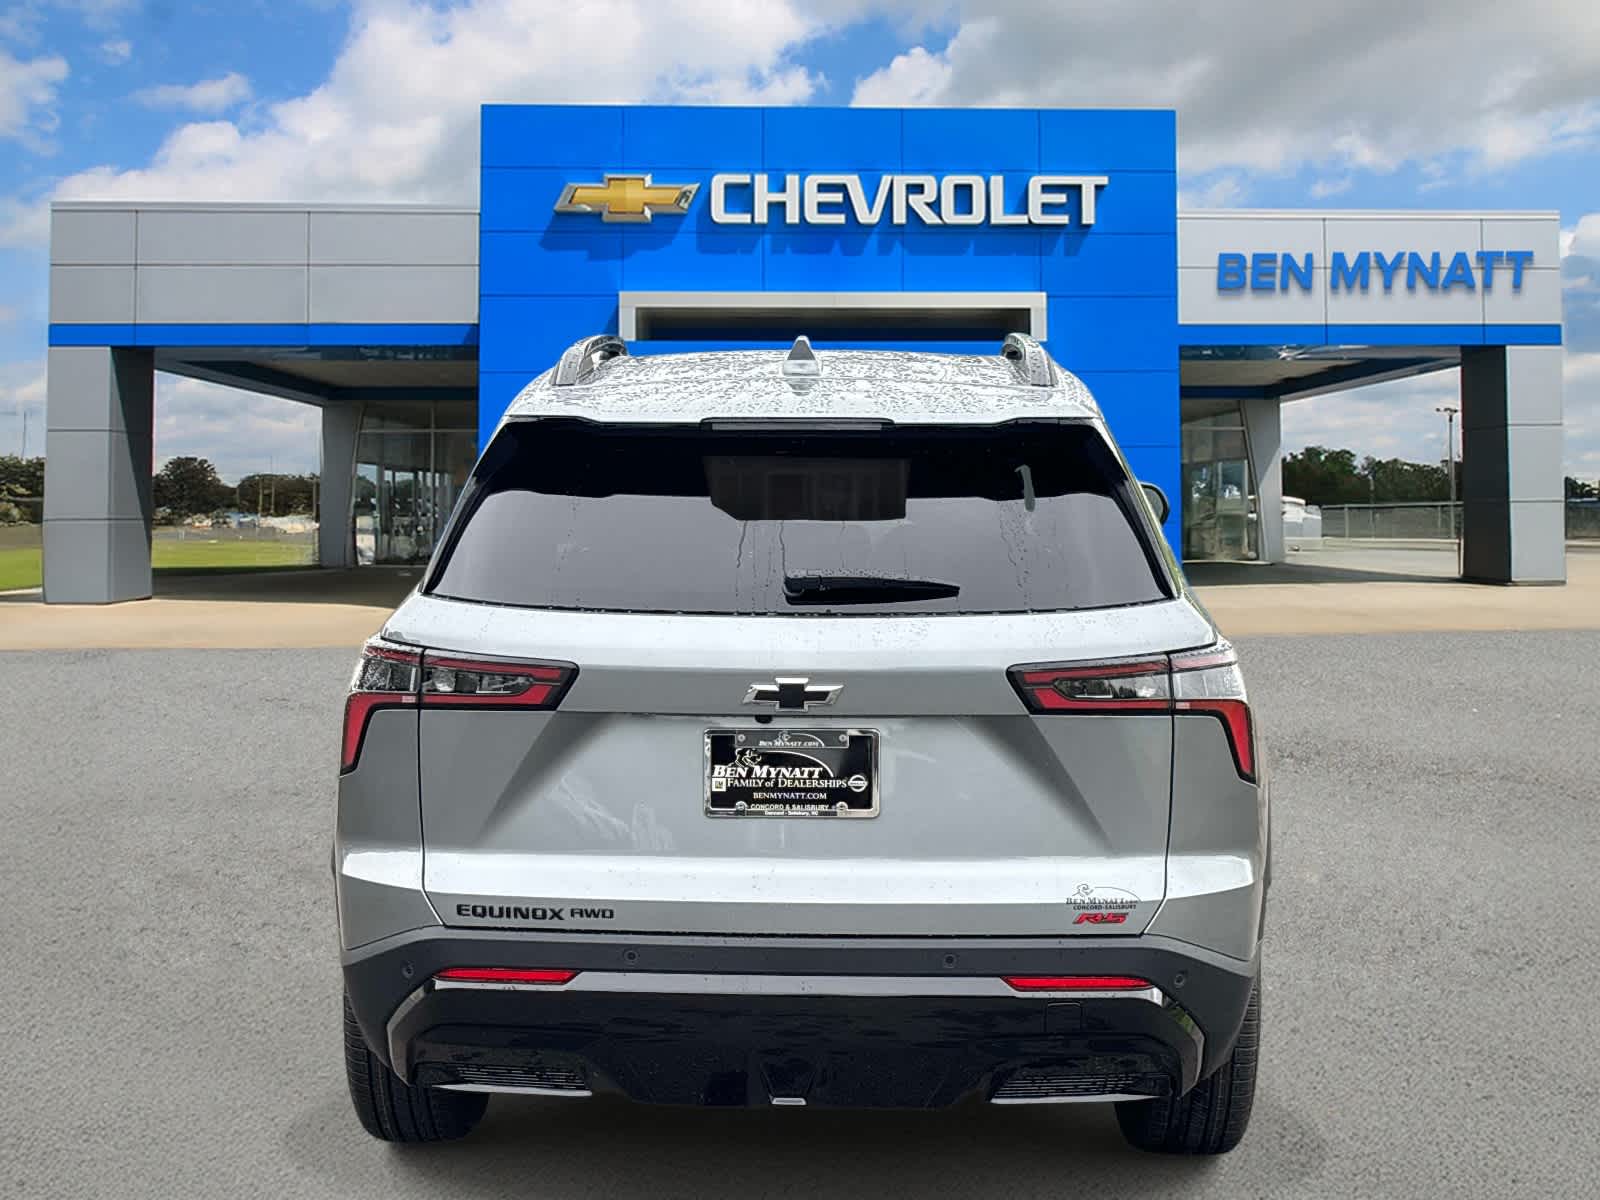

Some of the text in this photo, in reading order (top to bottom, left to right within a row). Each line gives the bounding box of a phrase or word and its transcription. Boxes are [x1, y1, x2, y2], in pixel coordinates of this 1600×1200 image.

[710, 173, 1110, 226] CHEVROLET
[1216, 250, 1534, 291] BEN MYNATT
[713, 765, 823, 778] BEN MYNATT
[727, 778, 764, 788] FAMILY
[765, 778, 775, 788] of
[778, 777, 847, 788] DEALERSHIPS
[752, 791, 827, 800] BENMYNATT.COM
[1066, 897, 1086, 905] BEN
[456, 903, 614, 920] EQUINOX AWD
[1072, 912, 1129, 925] RS
